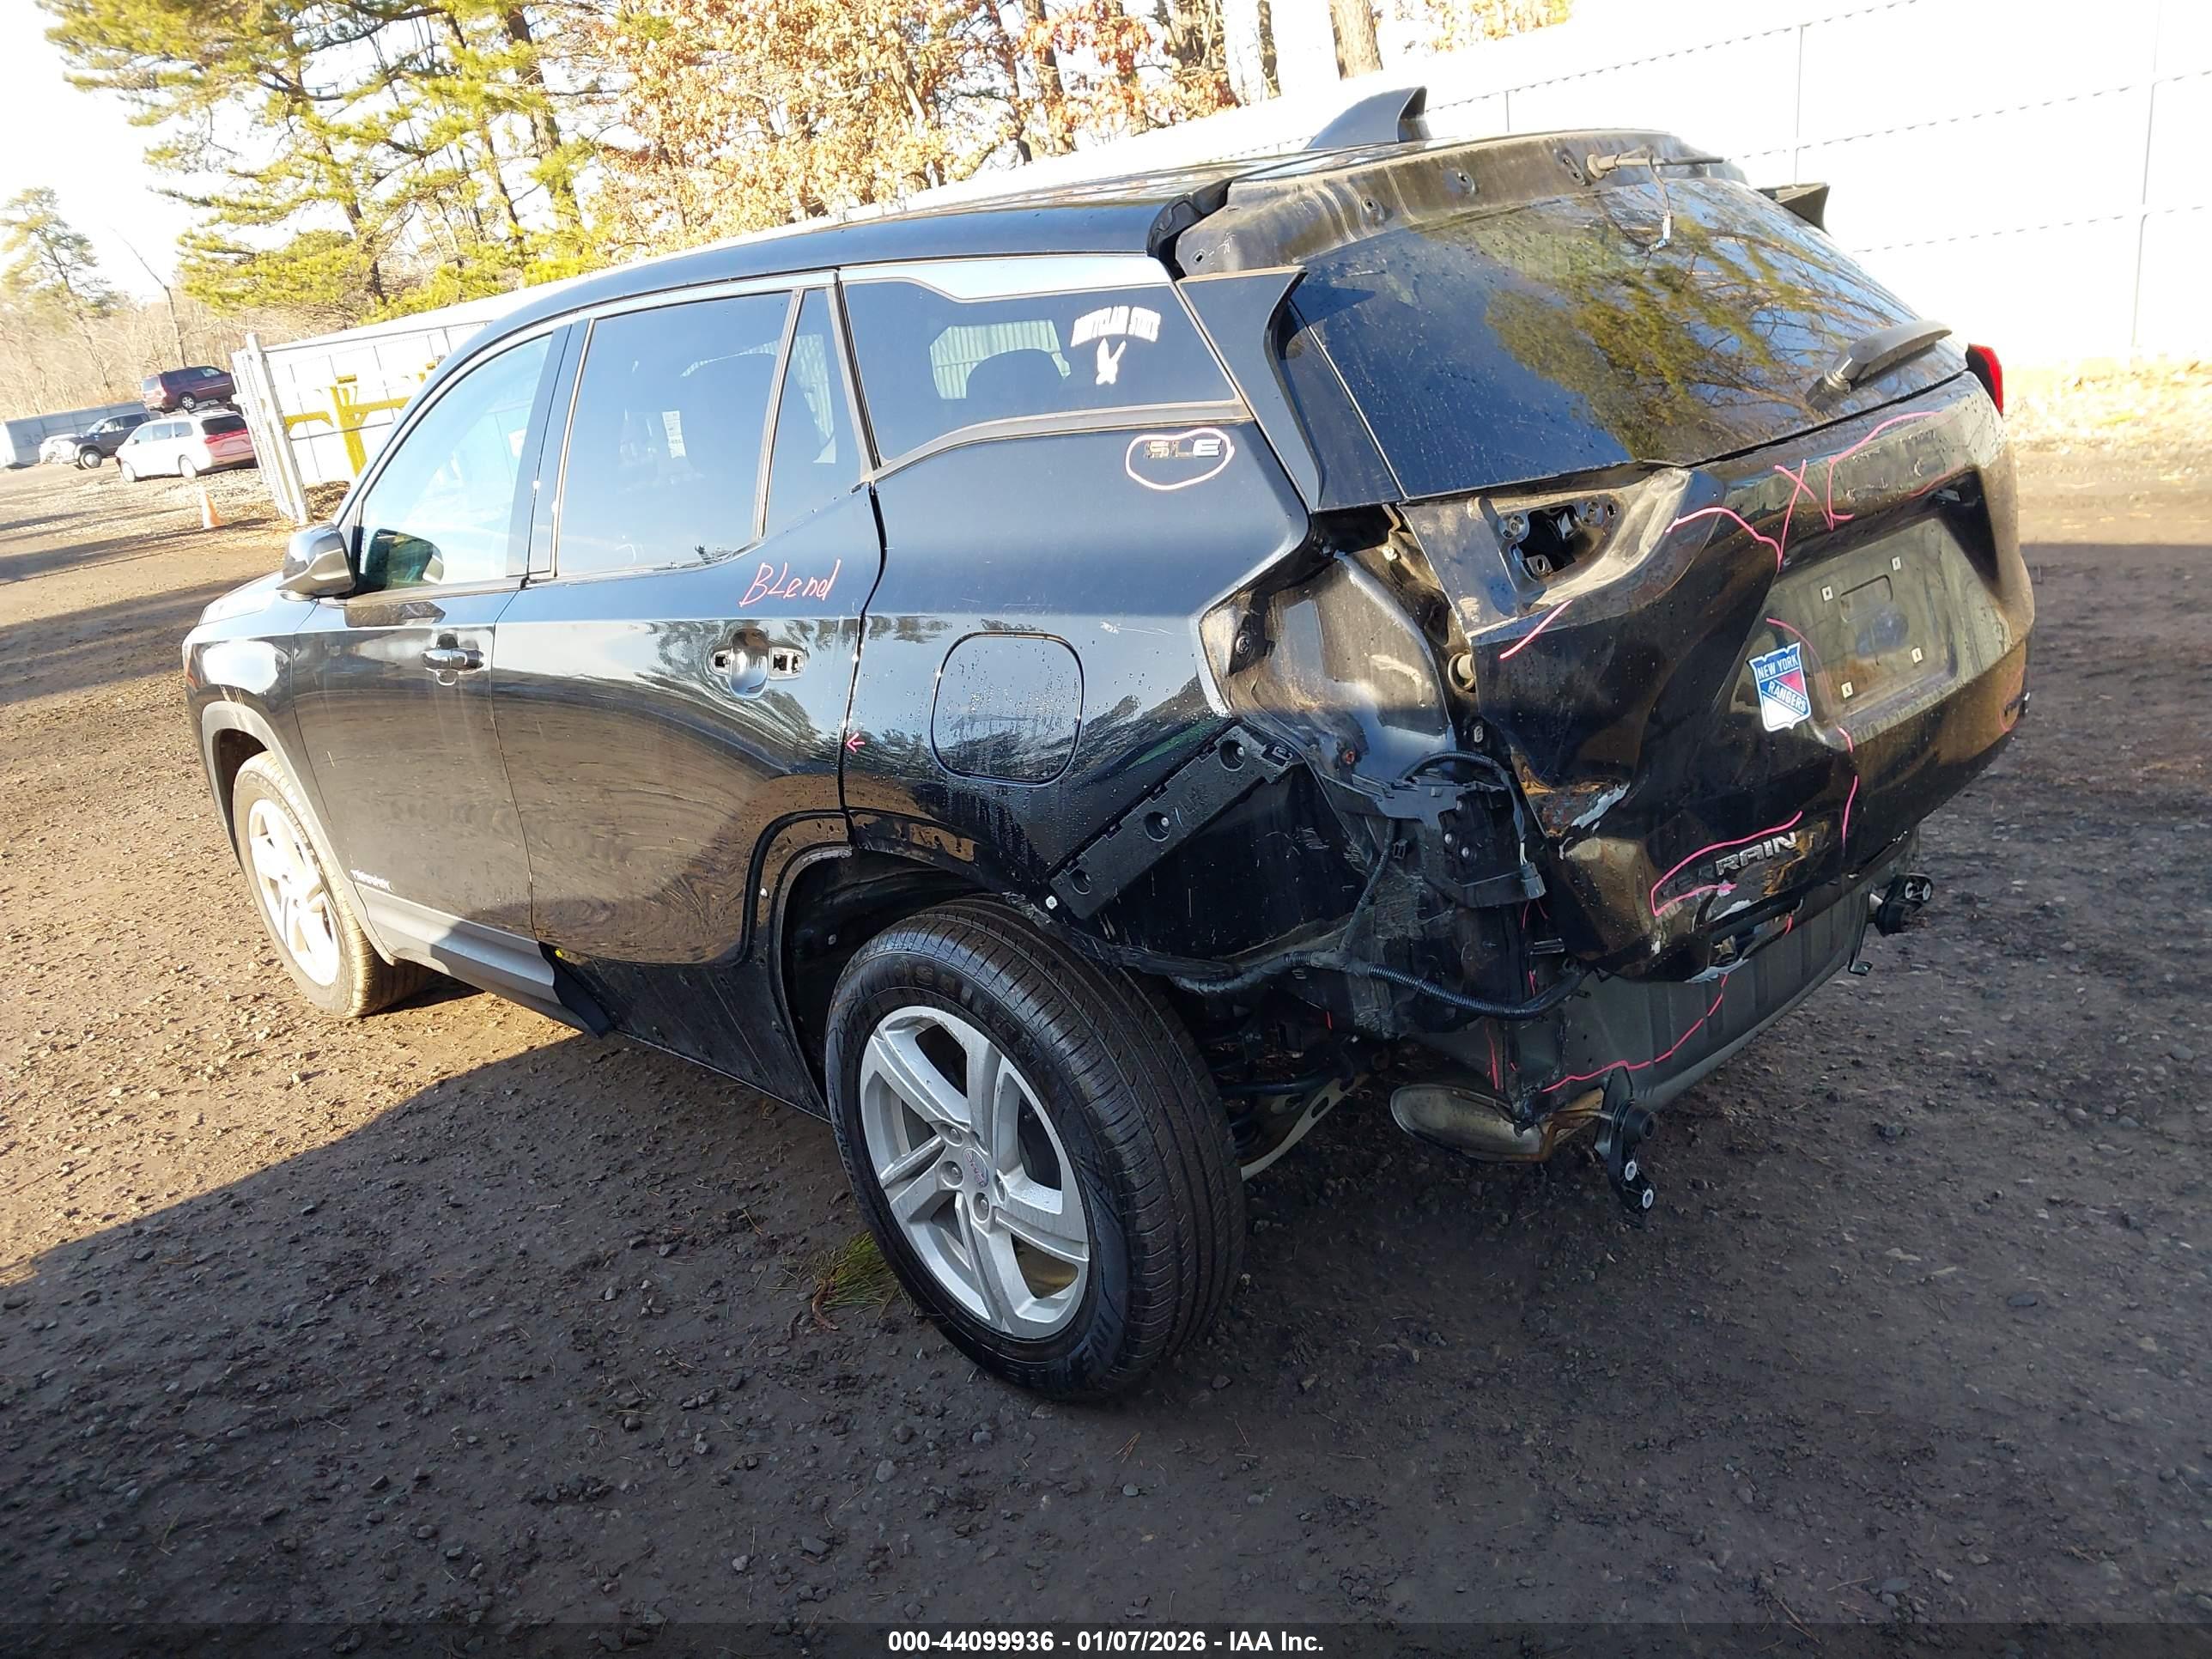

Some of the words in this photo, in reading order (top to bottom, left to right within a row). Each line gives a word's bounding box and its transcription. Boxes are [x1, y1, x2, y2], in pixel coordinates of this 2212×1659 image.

[1145, 438, 1223, 459] SLE
[1757, 661, 1776, 679] NEW
[1778, 653, 1799, 672] YORK
[1767, 680, 1807, 713] RANGERS
